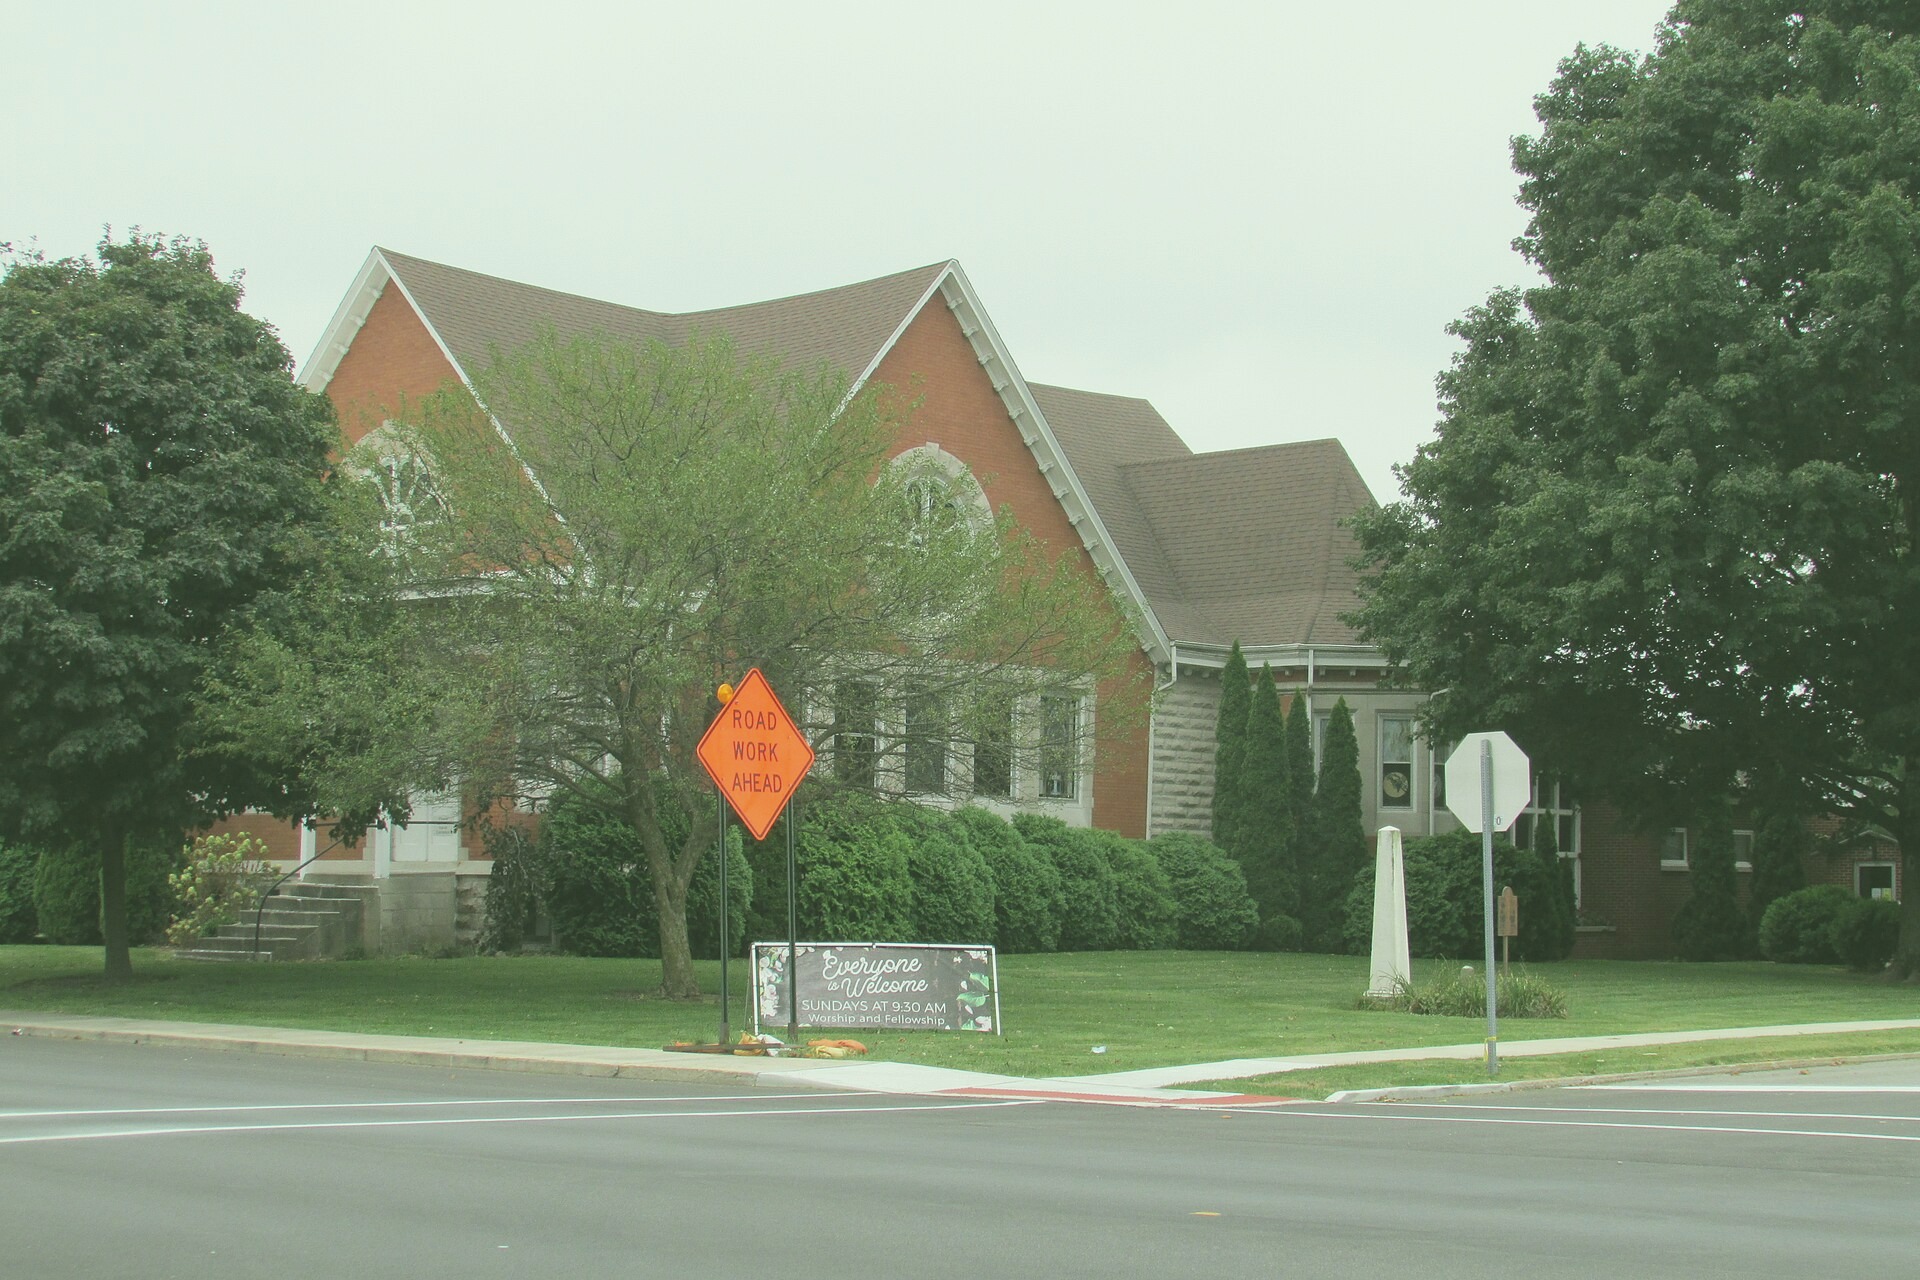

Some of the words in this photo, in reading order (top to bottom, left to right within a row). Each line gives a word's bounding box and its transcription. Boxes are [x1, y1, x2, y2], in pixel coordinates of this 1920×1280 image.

[732, 709, 777, 731] ROAD
[732, 741, 779, 762] WORK
[731, 772, 782, 793] AHEAD
[822, 955, 922, 982] Everyone
[827, 980, 840, 991] is
[840, 976, 928, 998] Welcome
[801, 1000, 868, 1012] SUNDAYS
[871, 1000, 888, 1012] AT
[892, 1001, 920, 1013] 9:30
[924, 1002, 946, 1014] AM
[808, 1014, 856, 1024] Worship
[859, 1014, 881, 1023] and
[885, 1014, 945, 1025] Fellowship
